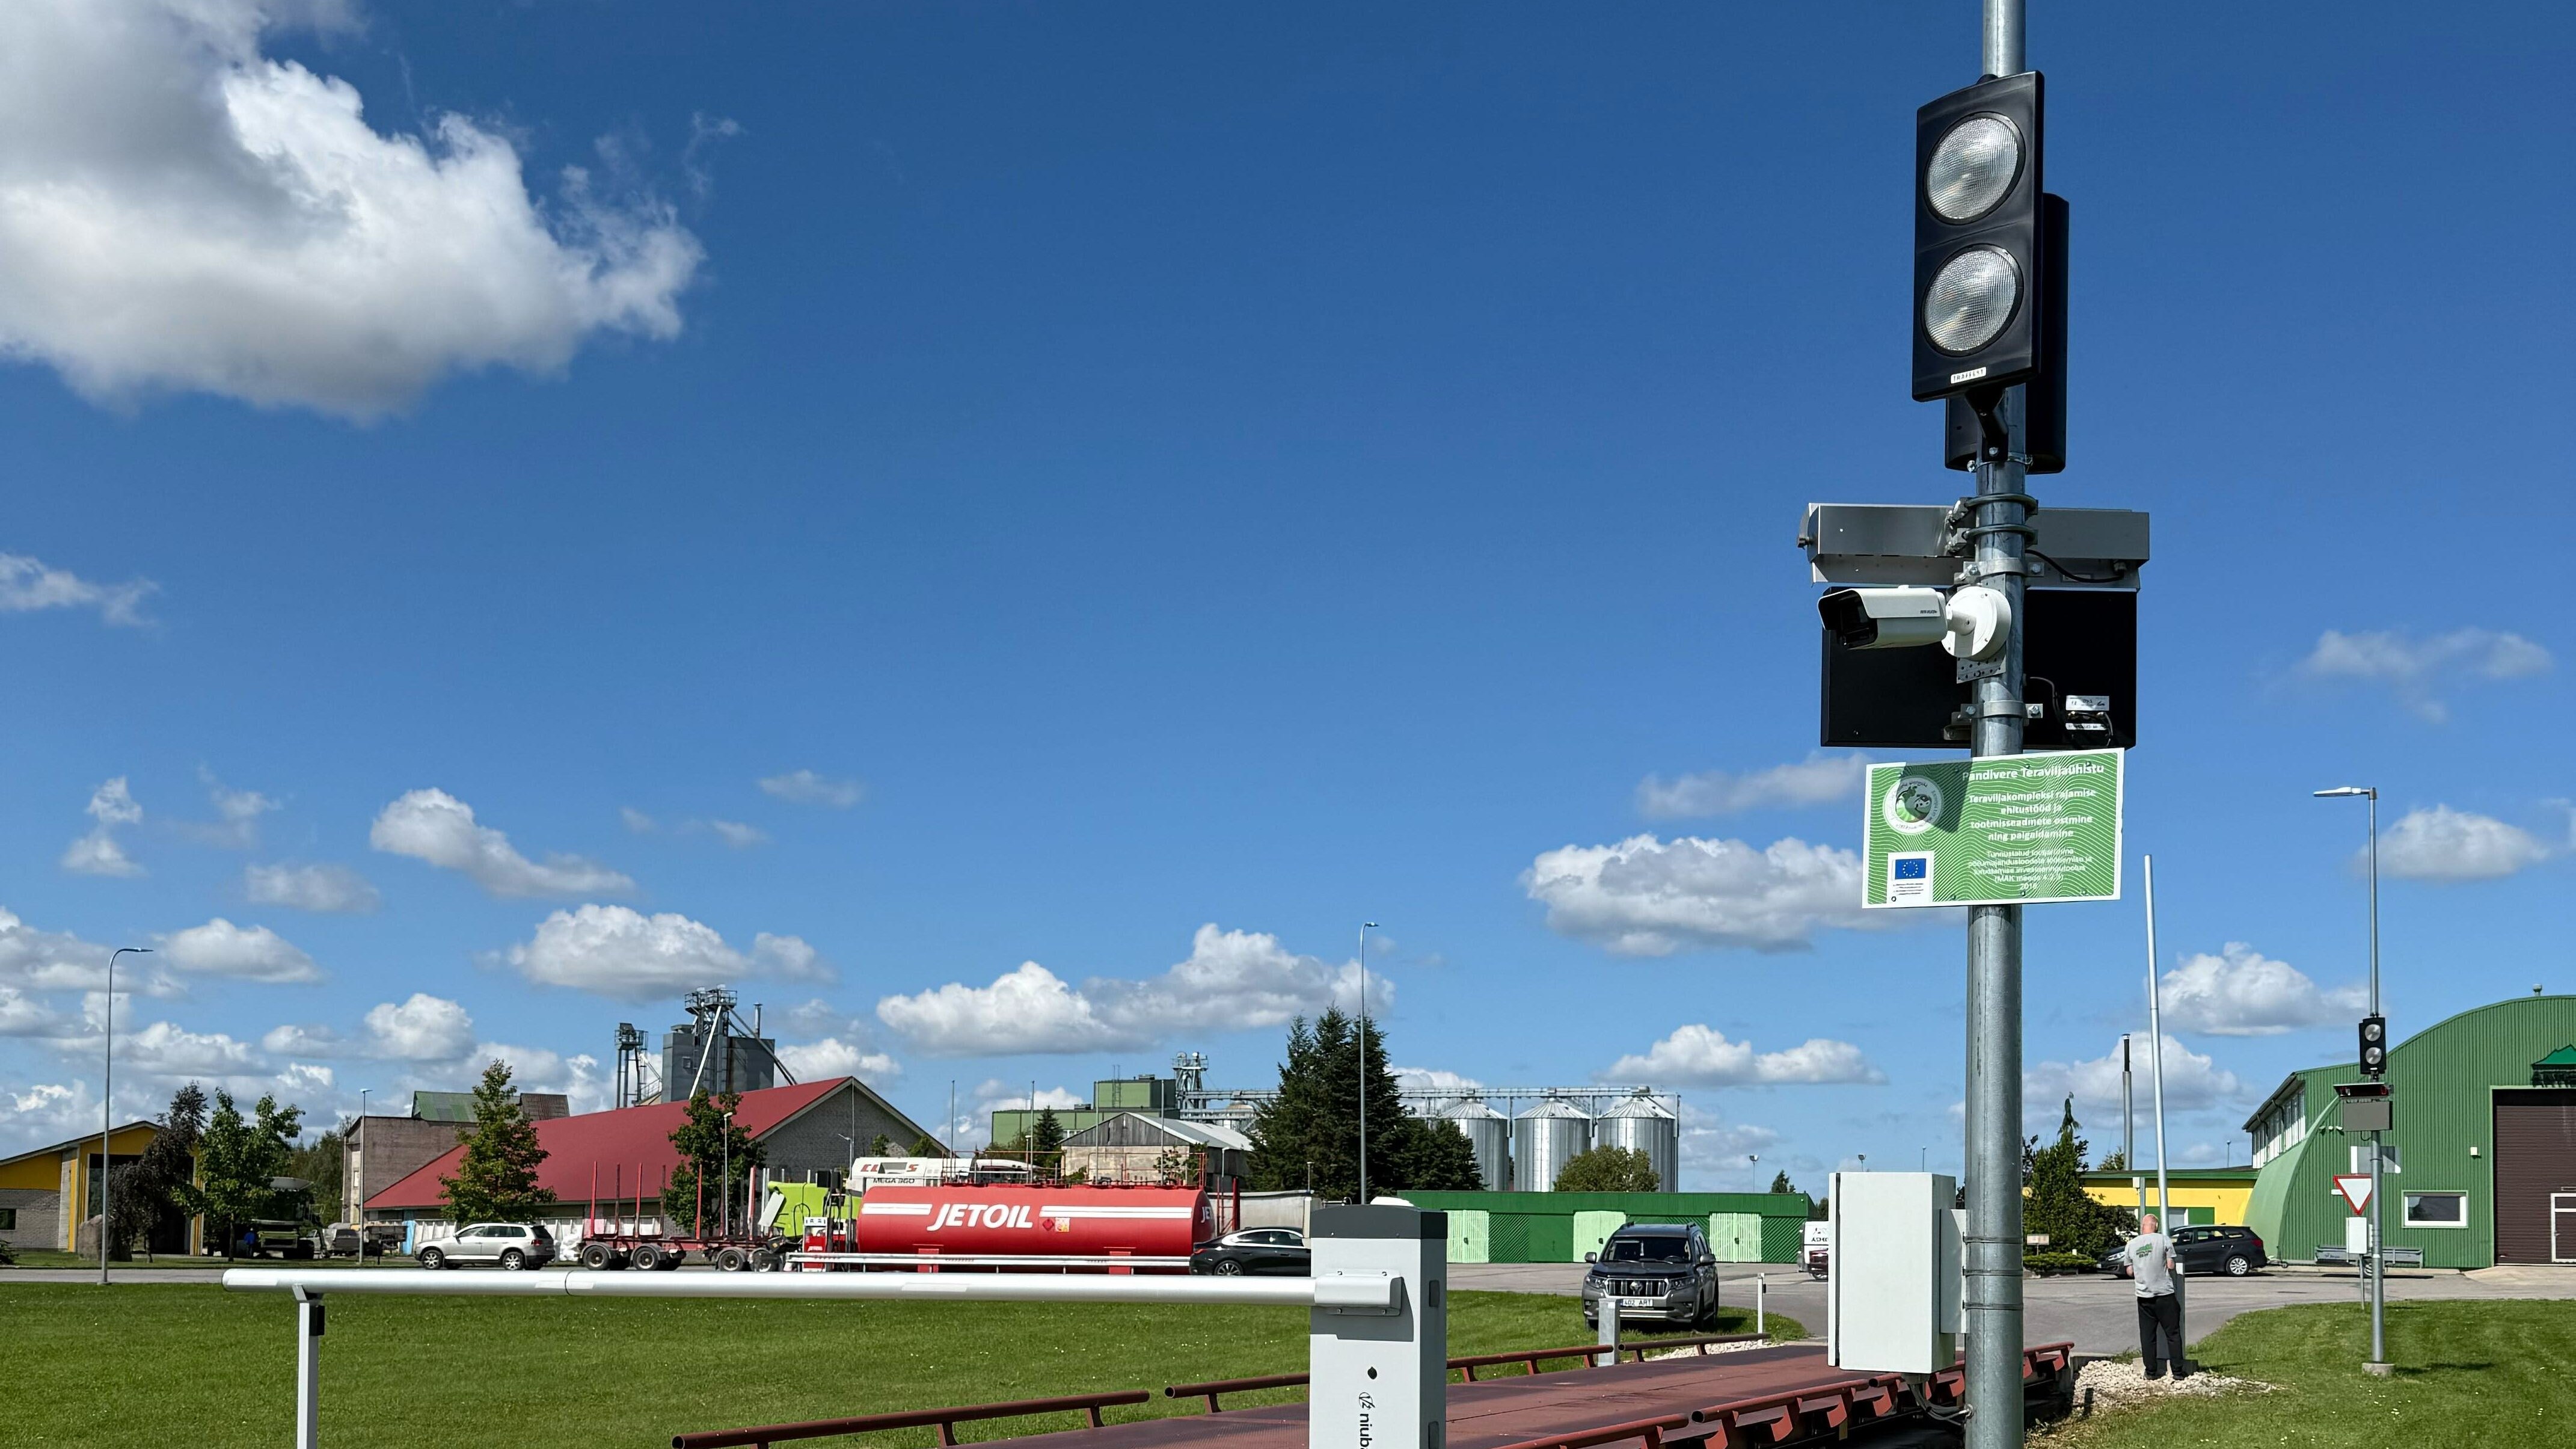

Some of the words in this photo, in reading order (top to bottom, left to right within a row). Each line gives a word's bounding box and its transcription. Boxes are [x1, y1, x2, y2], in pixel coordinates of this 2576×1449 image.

[1963, 769, 2018, 781] Pandivere
[2020, 763, 2104, 778] Teraviljaühistu
[1969, 790, 2054, 803] Teraviljakompleksi
[2056, 788, 2096, 800] rajamise
[1970, 817, 2052, 828] tootmisseadmete
[2054, 815, 2093, 825] ostmine
[1988, 832, 2008, 842] ning
[2010, 829, 2074, 840] paigaldamine
[927, 1204, 1033, 1231] JETOIL
[1360, 1414, 1372, 1449] niub
